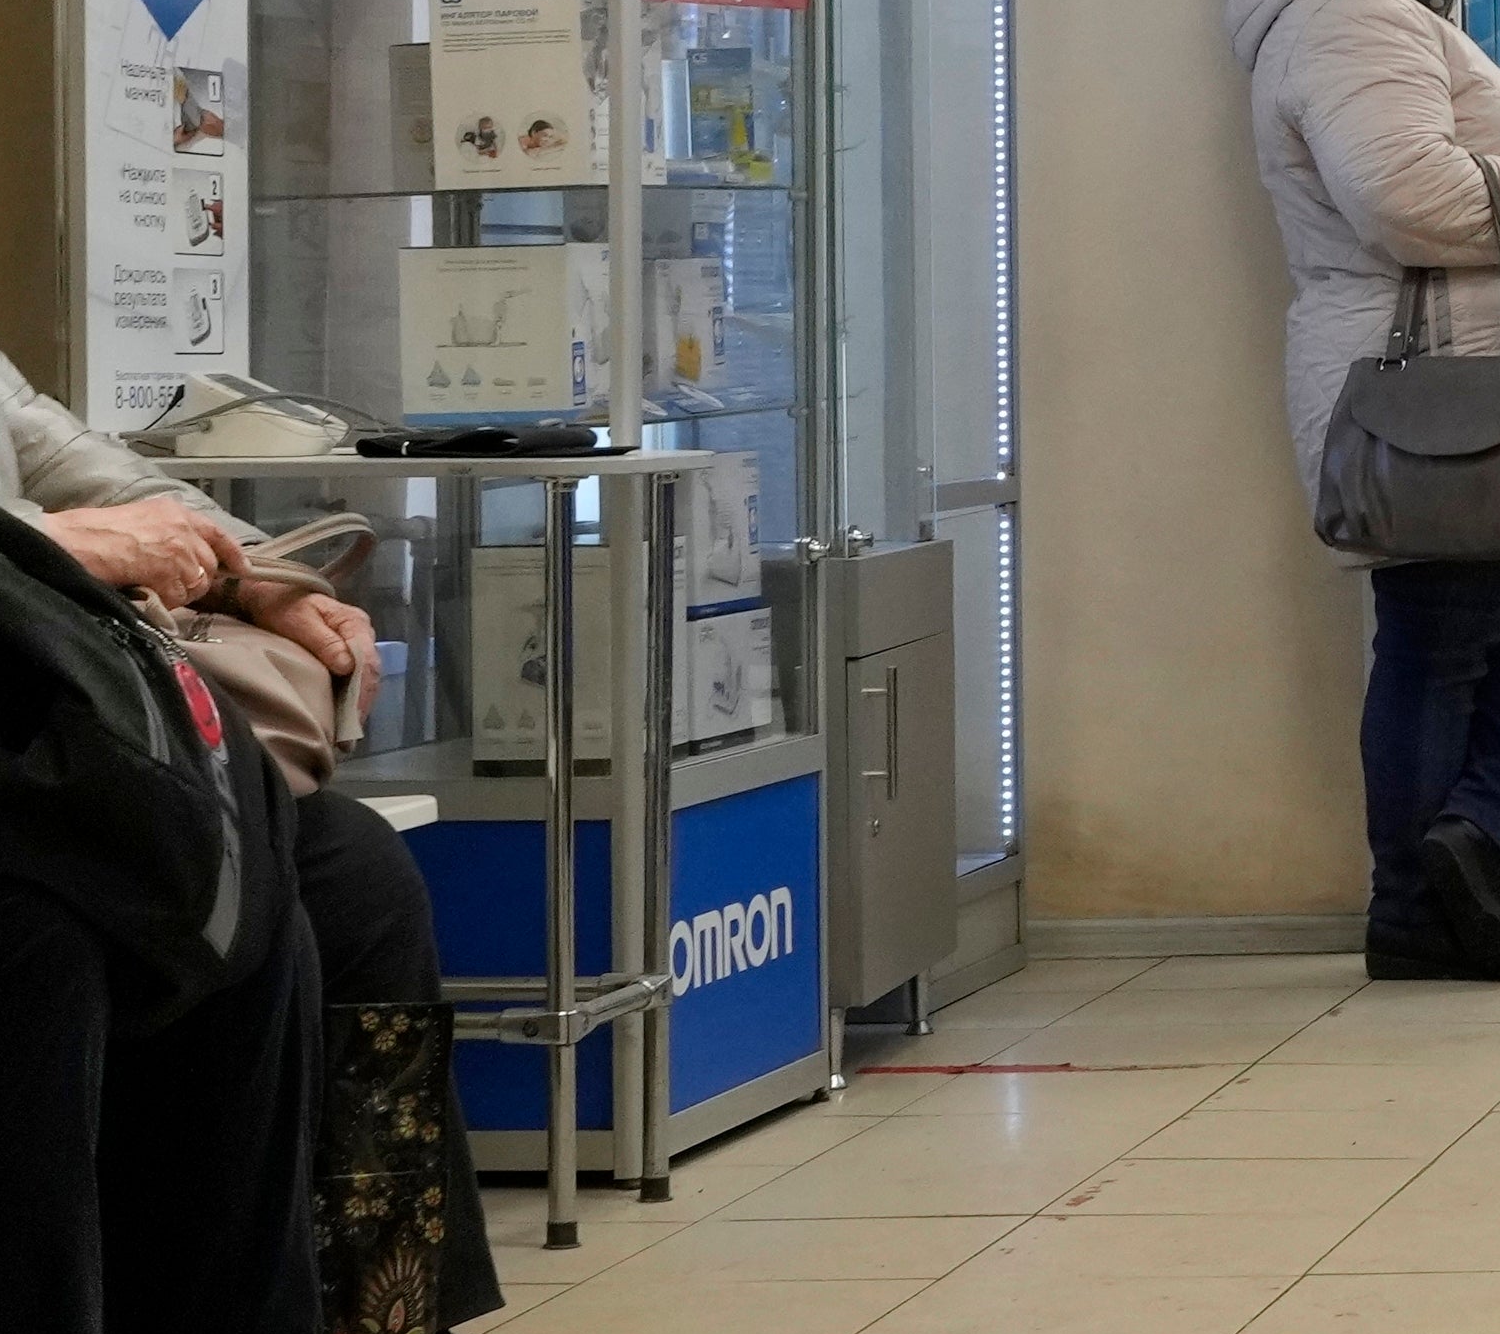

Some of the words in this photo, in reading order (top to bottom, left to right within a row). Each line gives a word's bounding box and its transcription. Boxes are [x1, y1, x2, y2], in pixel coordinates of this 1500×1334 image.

[211, 180, 218, 196] 2
[211, 279, 218, 294] 3
[670, 885, 793, 997] OMRON
